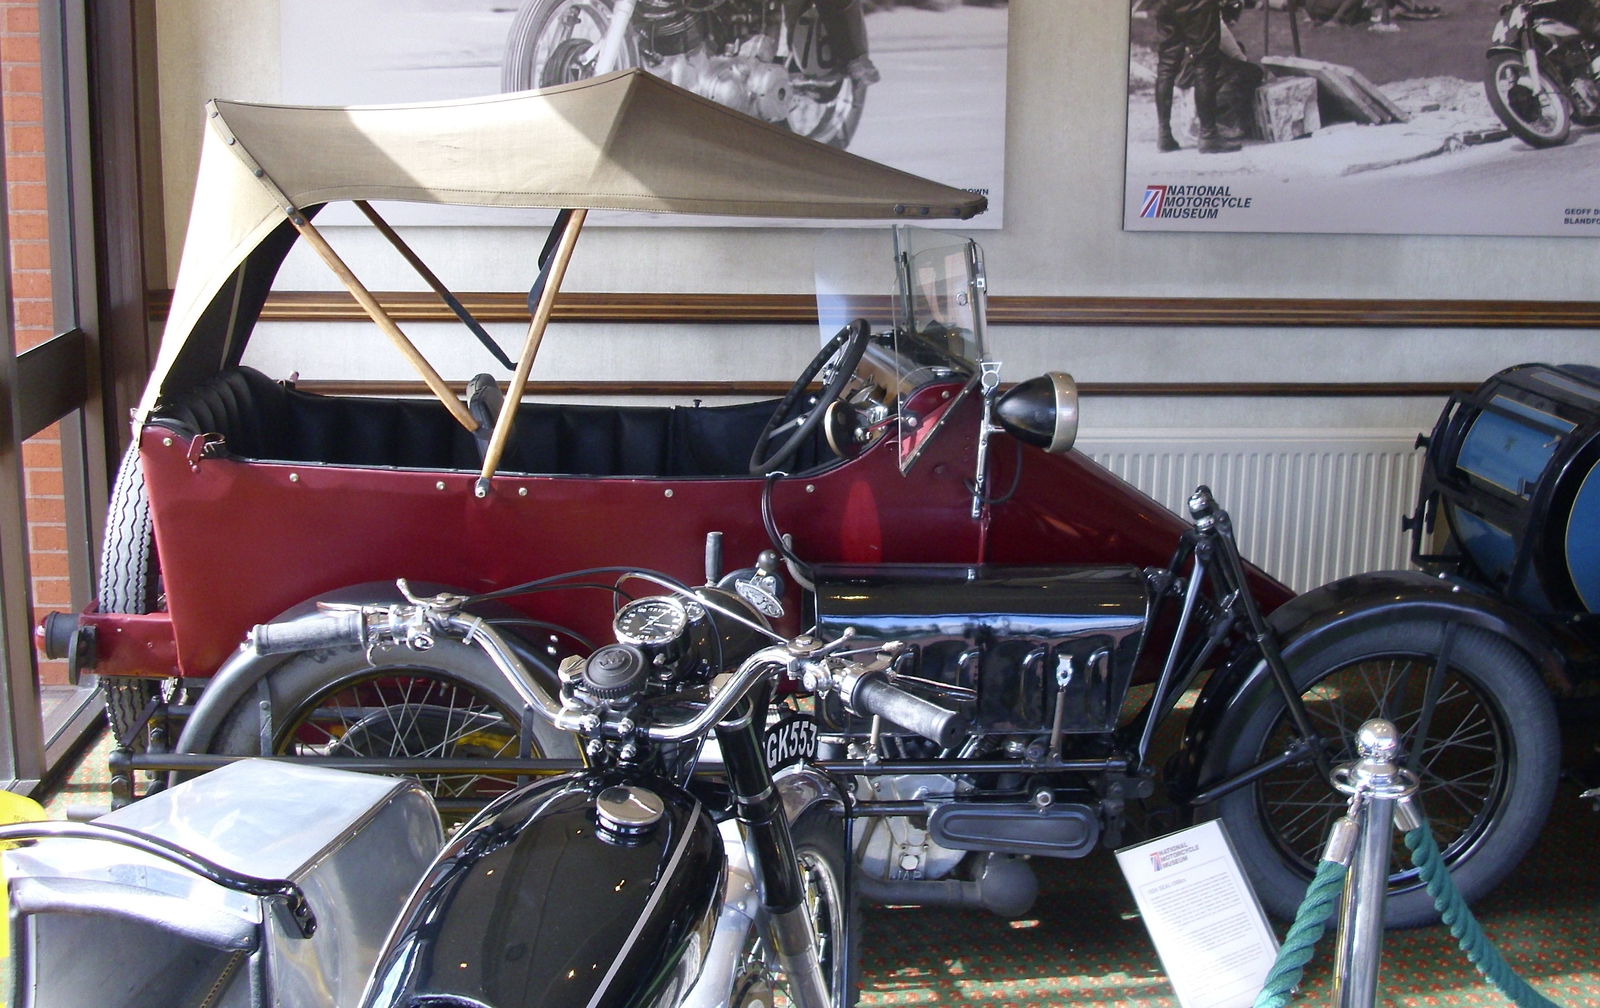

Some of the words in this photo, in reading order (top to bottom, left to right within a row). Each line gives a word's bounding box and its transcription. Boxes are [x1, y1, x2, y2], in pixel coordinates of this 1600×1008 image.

[1166, 185, 1232, 197] NATIONAL
[1164, 197, 1252, 208] MOTORCYCLE
[1161, 208, 1218, 219] MUSEUM
[1564, 208, 1591, 216] GEOFF
[762, 720, 817, 769] GK553
[1159, 842, 1188, 856] NATIONAL
[1160, 844, 1200, 862] MOTORCYCLE
[1162, 855, 1188, 868] MUSEUM
